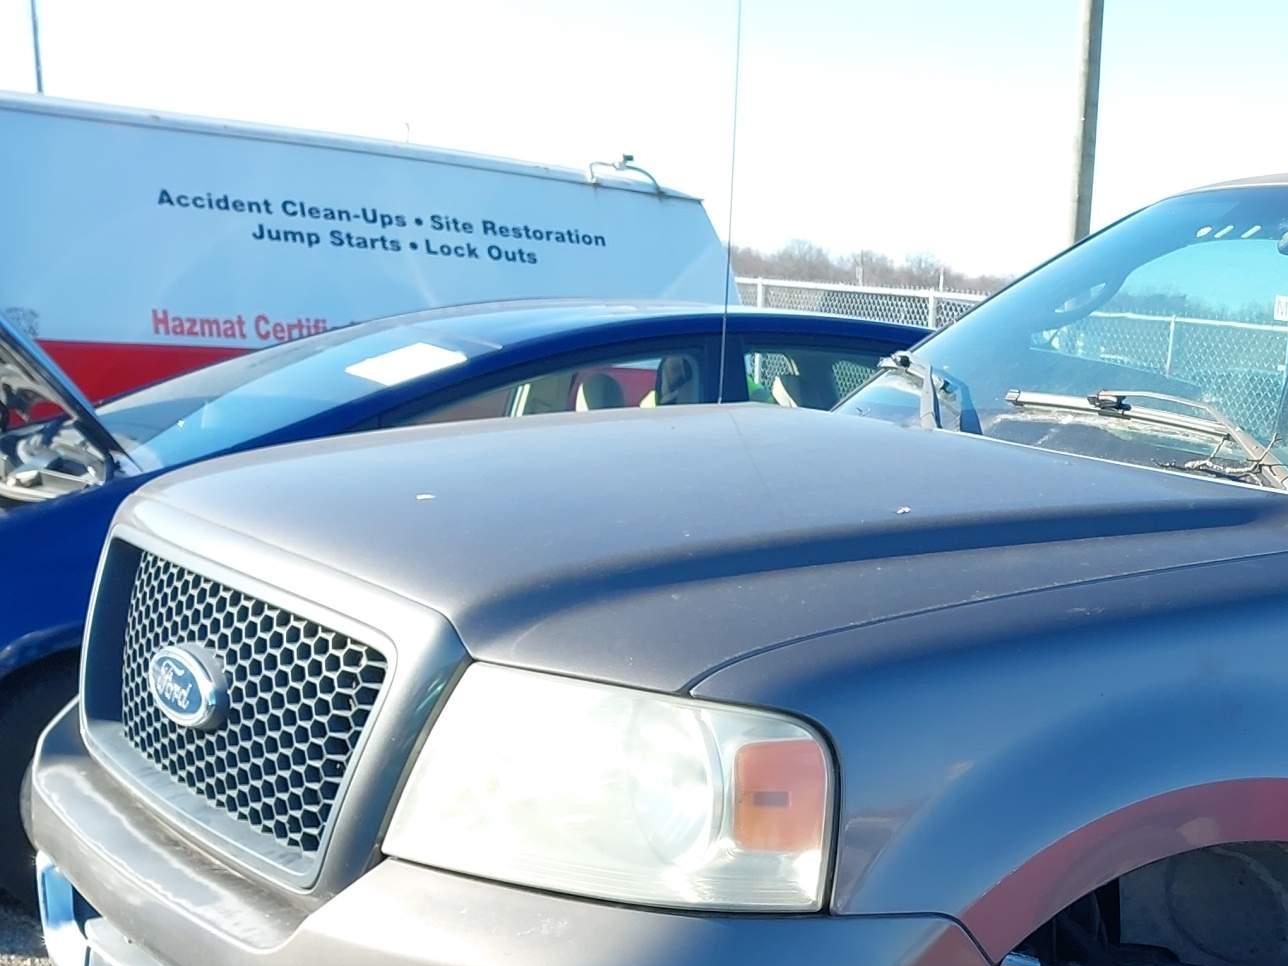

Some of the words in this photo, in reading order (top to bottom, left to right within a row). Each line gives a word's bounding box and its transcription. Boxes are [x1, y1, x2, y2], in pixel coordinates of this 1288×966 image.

[157, 188, 273, 216] Accident
[281, 200, 406, 228] Clean-Ups
[430, 215, 474, 234] Site
[482, 219, 606, 247] Restoration
[252, 223, 320, 248] Jump
[329, 230, 402, 252] Starts
[424, 239, 479, 259] Lock
[487, 245, 538, 265] Outs
[151, 308, 248, 340] Hazmat
[156, 660, 193, 710] Ford
